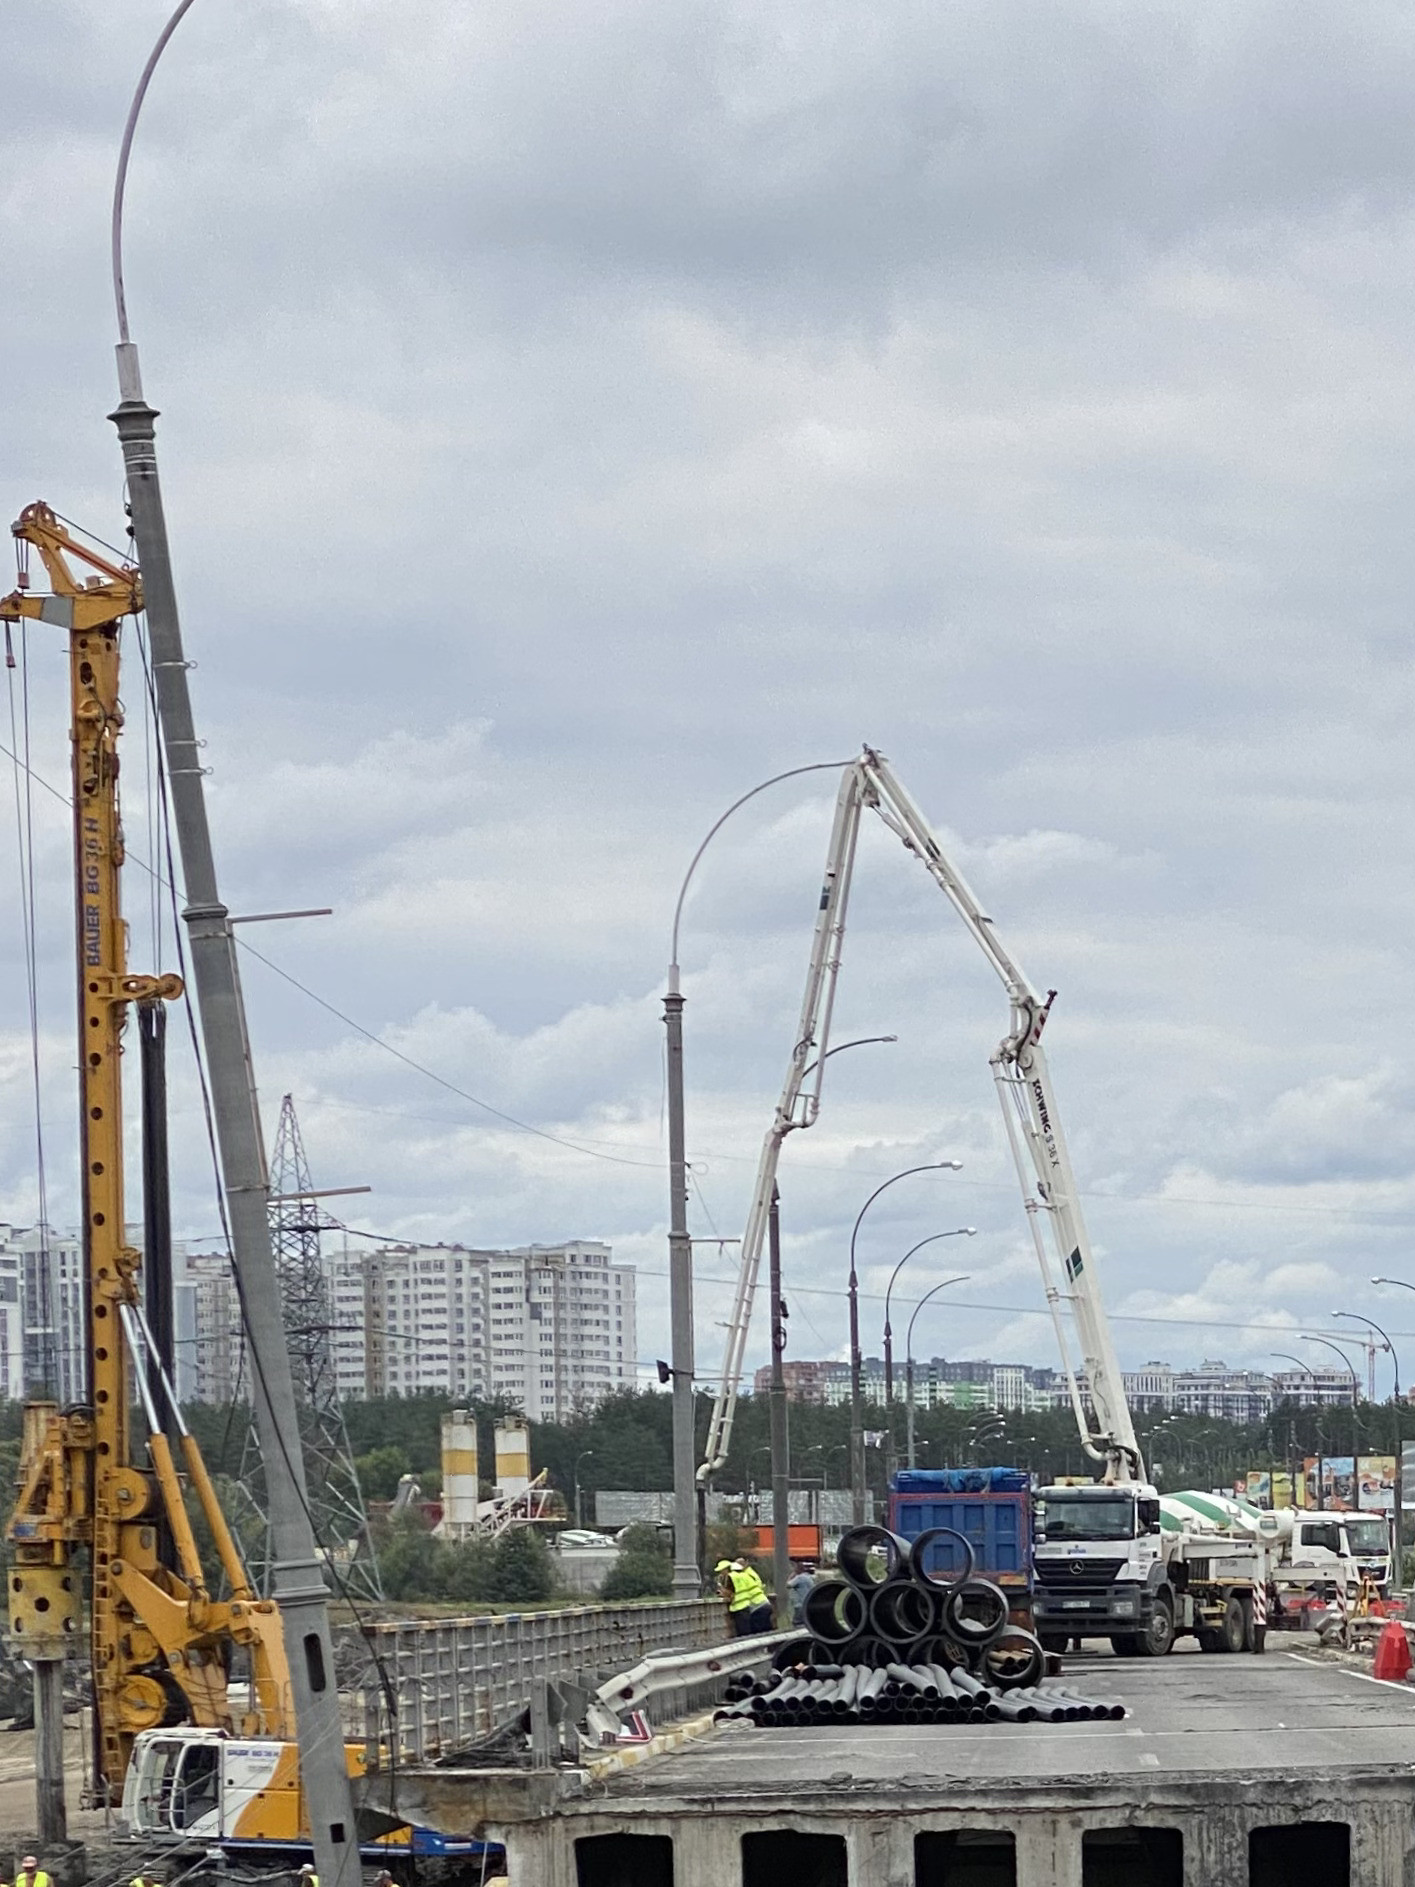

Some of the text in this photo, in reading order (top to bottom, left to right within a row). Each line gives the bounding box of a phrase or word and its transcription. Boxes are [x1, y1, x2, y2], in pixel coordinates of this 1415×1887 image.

[85, 818, 100, 967] BAUER BG 36 H
[1032, 1078, 1052, 1134] SCHWING
[1051, 1159, 1060, 1168] X
